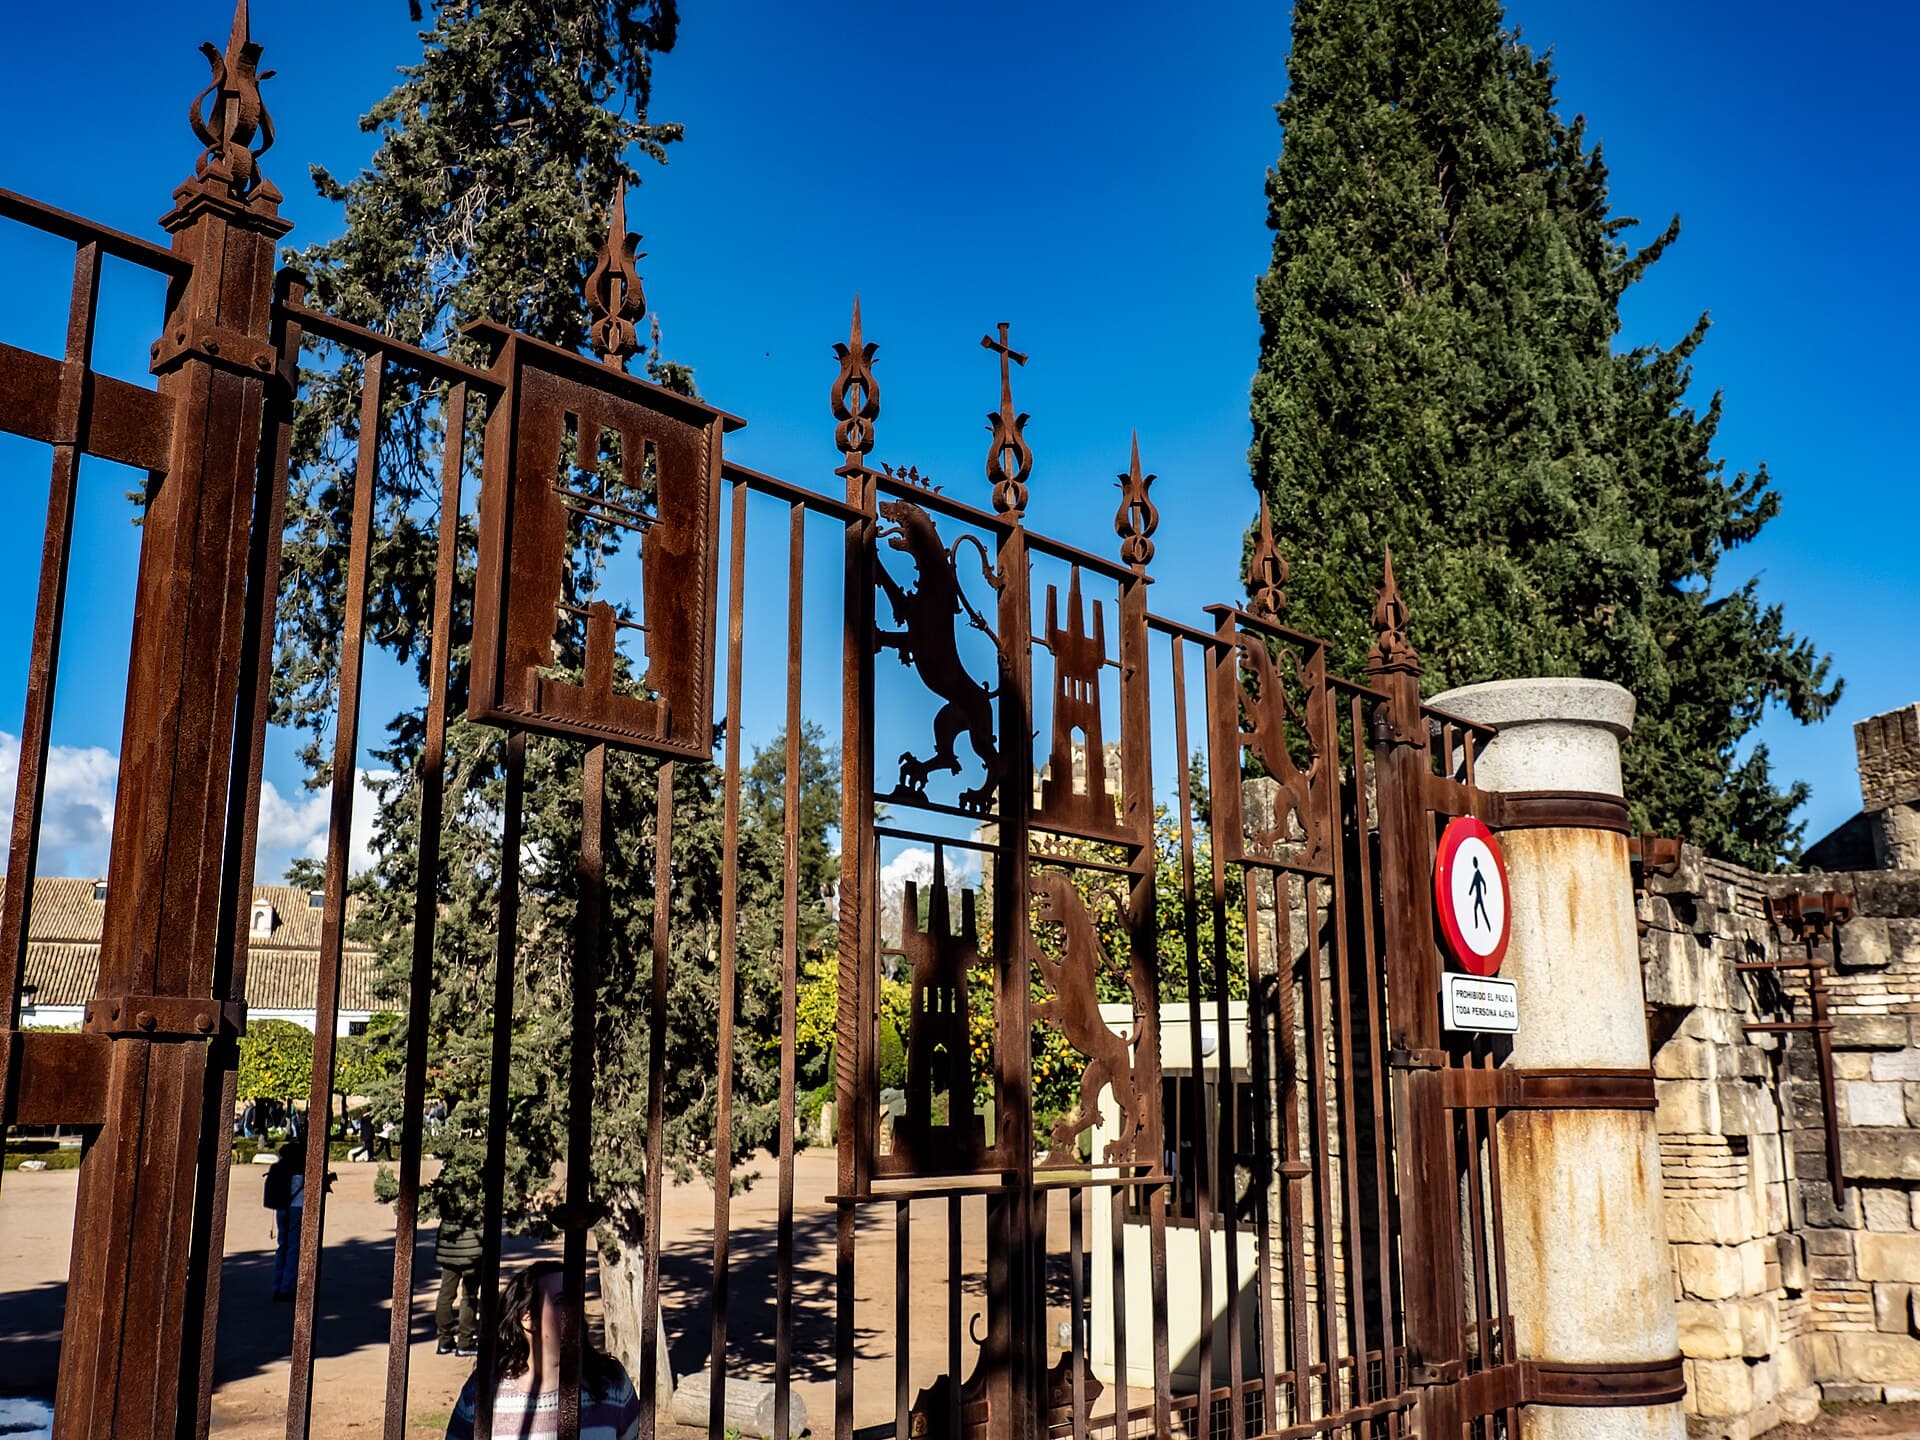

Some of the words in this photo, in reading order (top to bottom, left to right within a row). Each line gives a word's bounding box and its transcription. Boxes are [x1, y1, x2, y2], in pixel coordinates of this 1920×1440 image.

[1456, 989, 1486, 1001] PROHIBIDO
[1487, 992, 1494, 1002] EL
[1495, 993, 1509, 1003] PASO
[1456, 1005, 1470, 1015] TODA
[1472, 1006, 1497, 1017] PERSONA
[1498, 1009, 1515, 1018] AJENA
